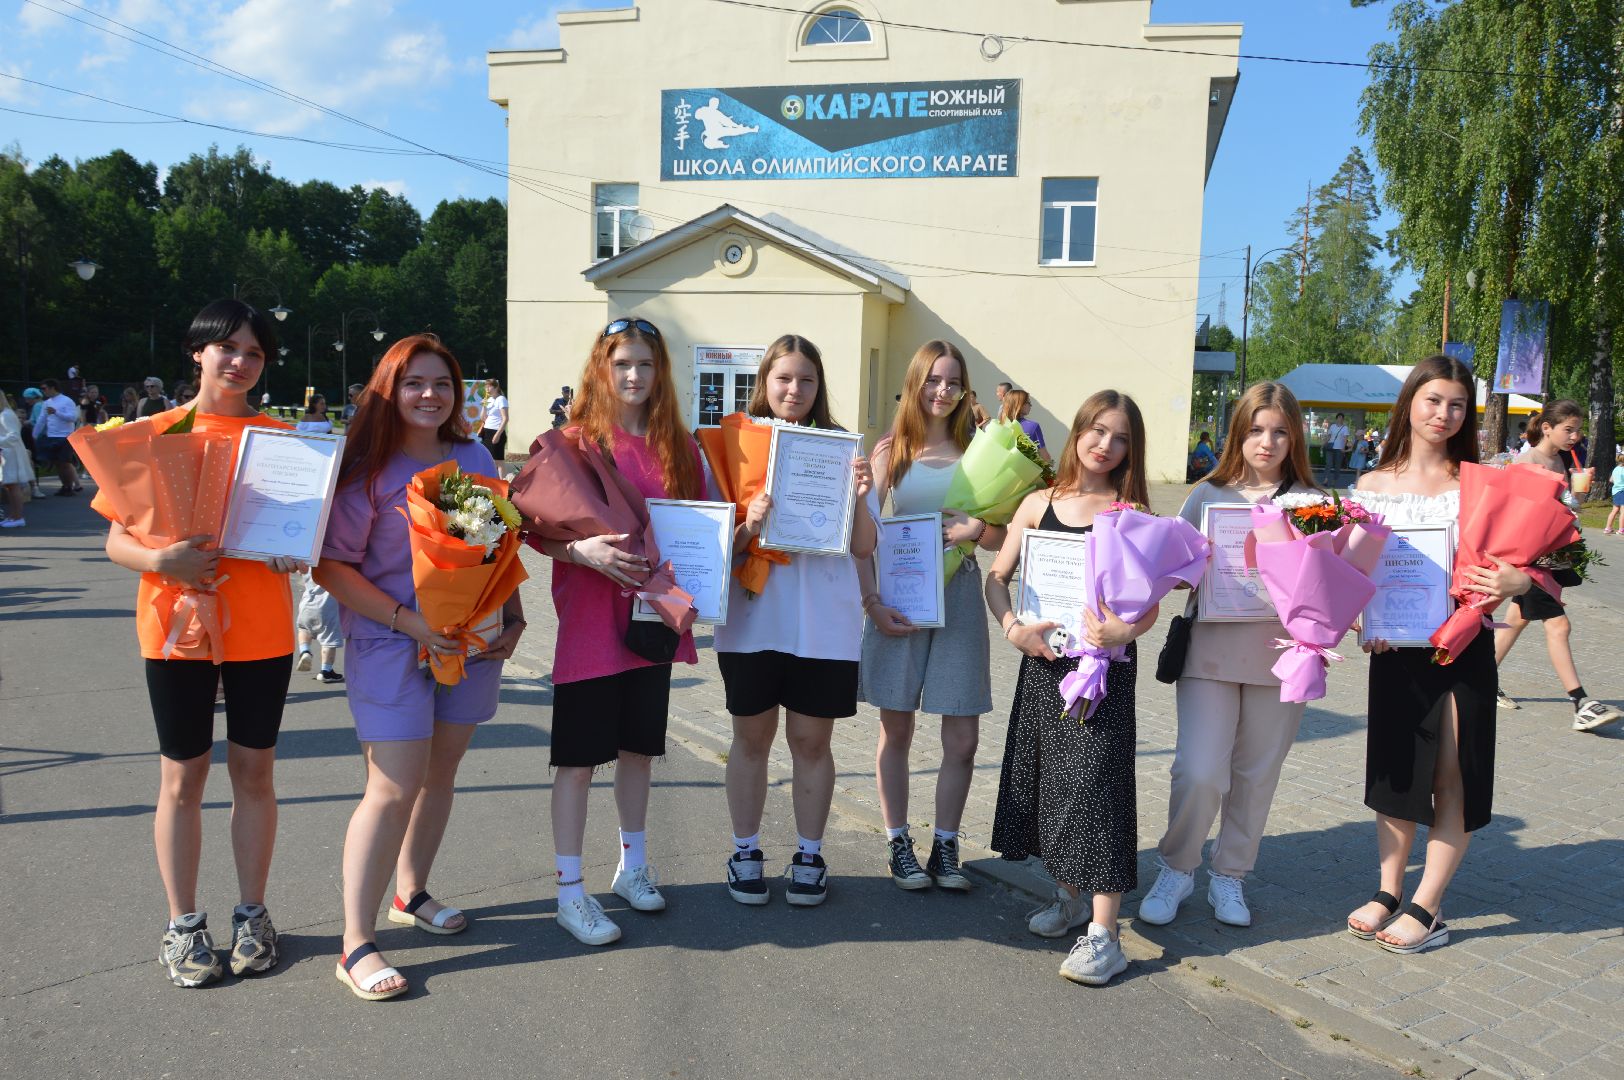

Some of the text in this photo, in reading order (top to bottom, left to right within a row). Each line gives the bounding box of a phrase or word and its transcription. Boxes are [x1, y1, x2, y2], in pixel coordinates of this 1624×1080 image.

[805, 85, 1005, 120] КАРАТЕ ЮЖНЫЙ
[929, 107, 1003, 118] СПОРТИВНЫЙ КЛУБ
[673, 98, 692, 150] 空手
[673, 153, 1008, 176] ШКОЛА ОЛИМПИЙСКОГО КАРАТЕ
[1385, 559, 1424, 567] ПИСЬМО
